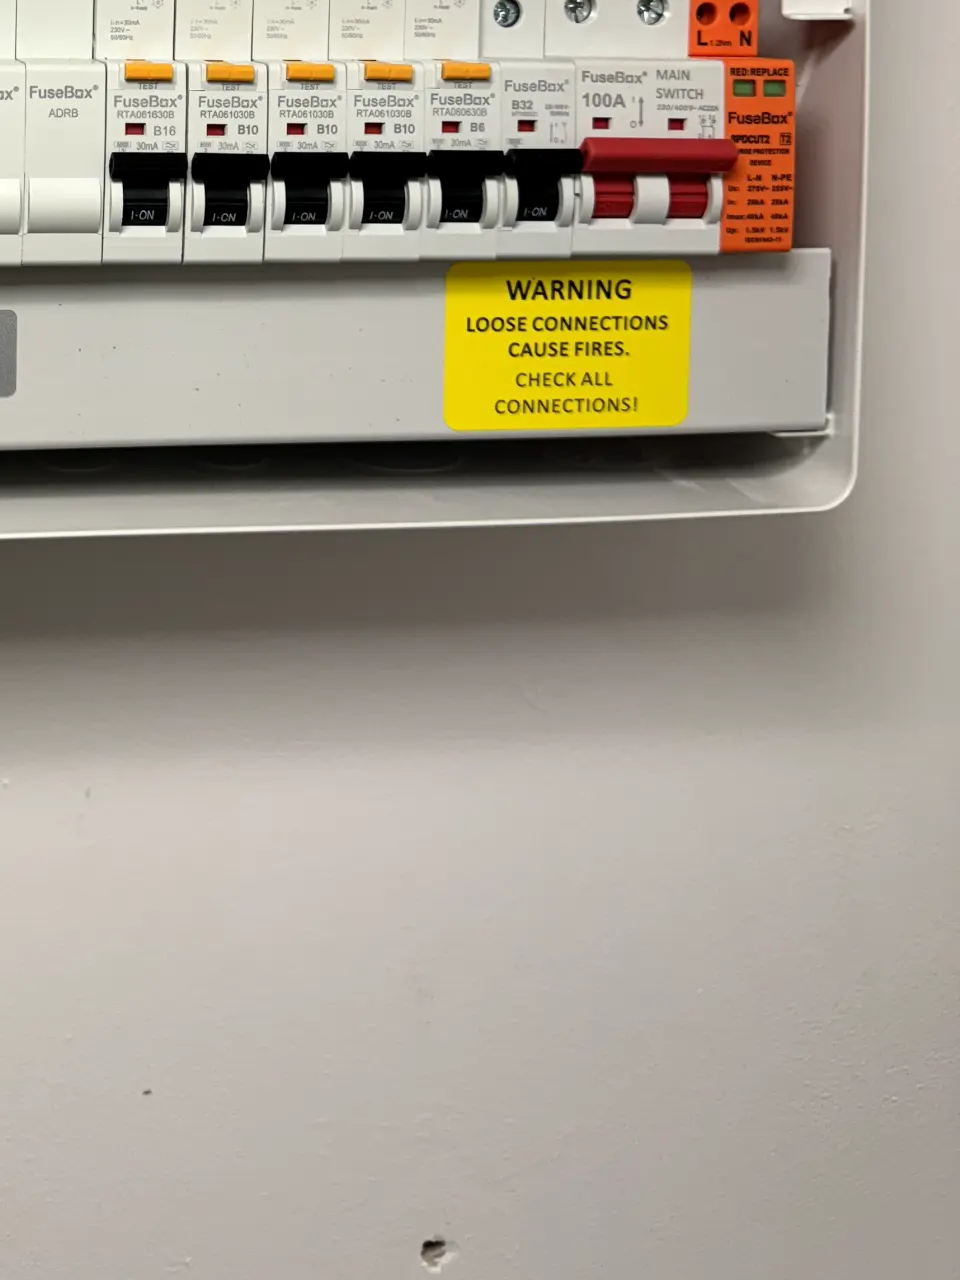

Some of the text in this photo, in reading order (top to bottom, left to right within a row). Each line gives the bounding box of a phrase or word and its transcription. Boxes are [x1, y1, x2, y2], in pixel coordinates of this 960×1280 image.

[697, 30, 708, 46] L
[740, 30, 752, 46] N
[656, 69, 691, 81] MAIN
[656, 88, 704, 100] SWITCH
[511, 100, 534, 110] B32
[582, 93, 626, 108] 100A
[49, 108, 79, 118] ADRB
[153, 126, 176, 136] B16
[237, 125, 259, 135] B10
[317, 124, 338, 135] B10
[394, 124, 415, 134] B10
[470, 123, 485, 132] B6
[136, 142, 159, 151] 30mA
[218, 142, 239, 151] 30mA
[297, 141, 318, 150] 30mA
[374, 141, 395, 149] 30mA
[450, 139, 472, 147] 30mA
[506, 279, 631, 300] WARNING
[467, 315, 668, 332] LOOSE CONNECTIONS
[508, 341, 630, 357] CAUSE FIRES.
[516, 372, 612, 387] CHECK ALL
[495, 397, 637, 414] CONNECTIONS!
